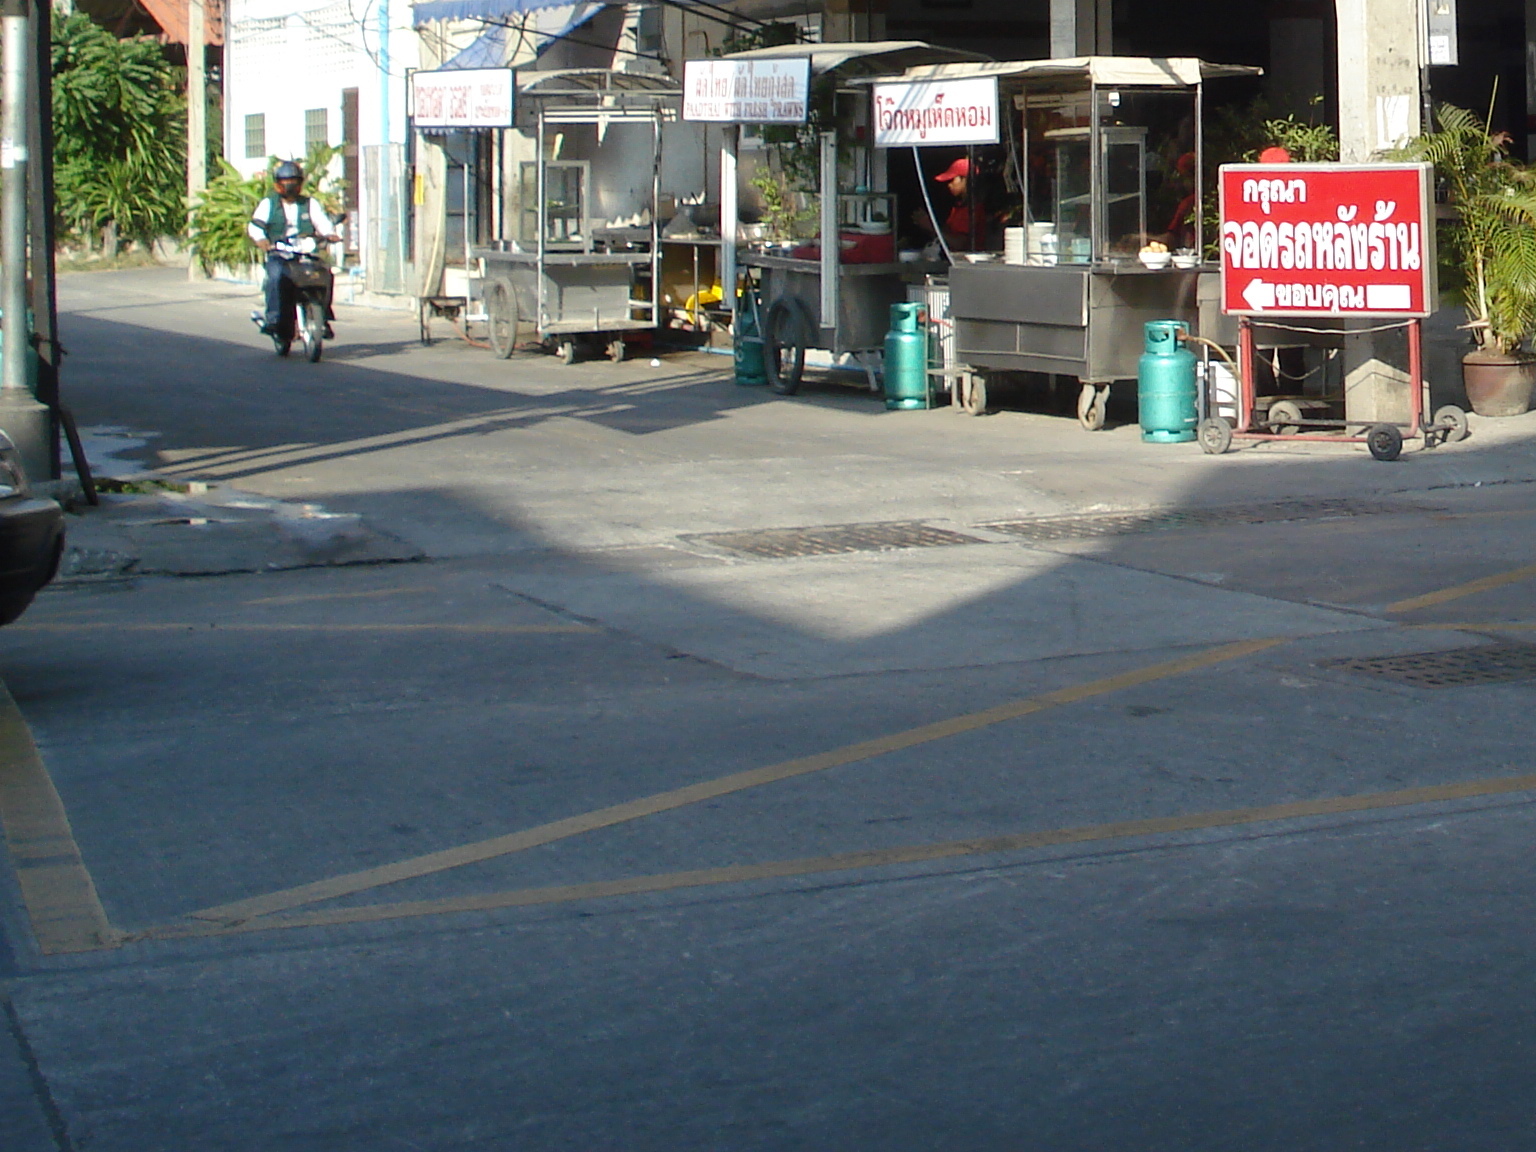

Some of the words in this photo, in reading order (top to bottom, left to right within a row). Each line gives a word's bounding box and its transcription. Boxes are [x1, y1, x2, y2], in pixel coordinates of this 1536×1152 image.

[1242, 179, 1307, 214] กรุณา
[1223, 201, 1422, 271] จอดรถหลังร้าน
[1275, 283, 1365, 313] ขอบคุณ
